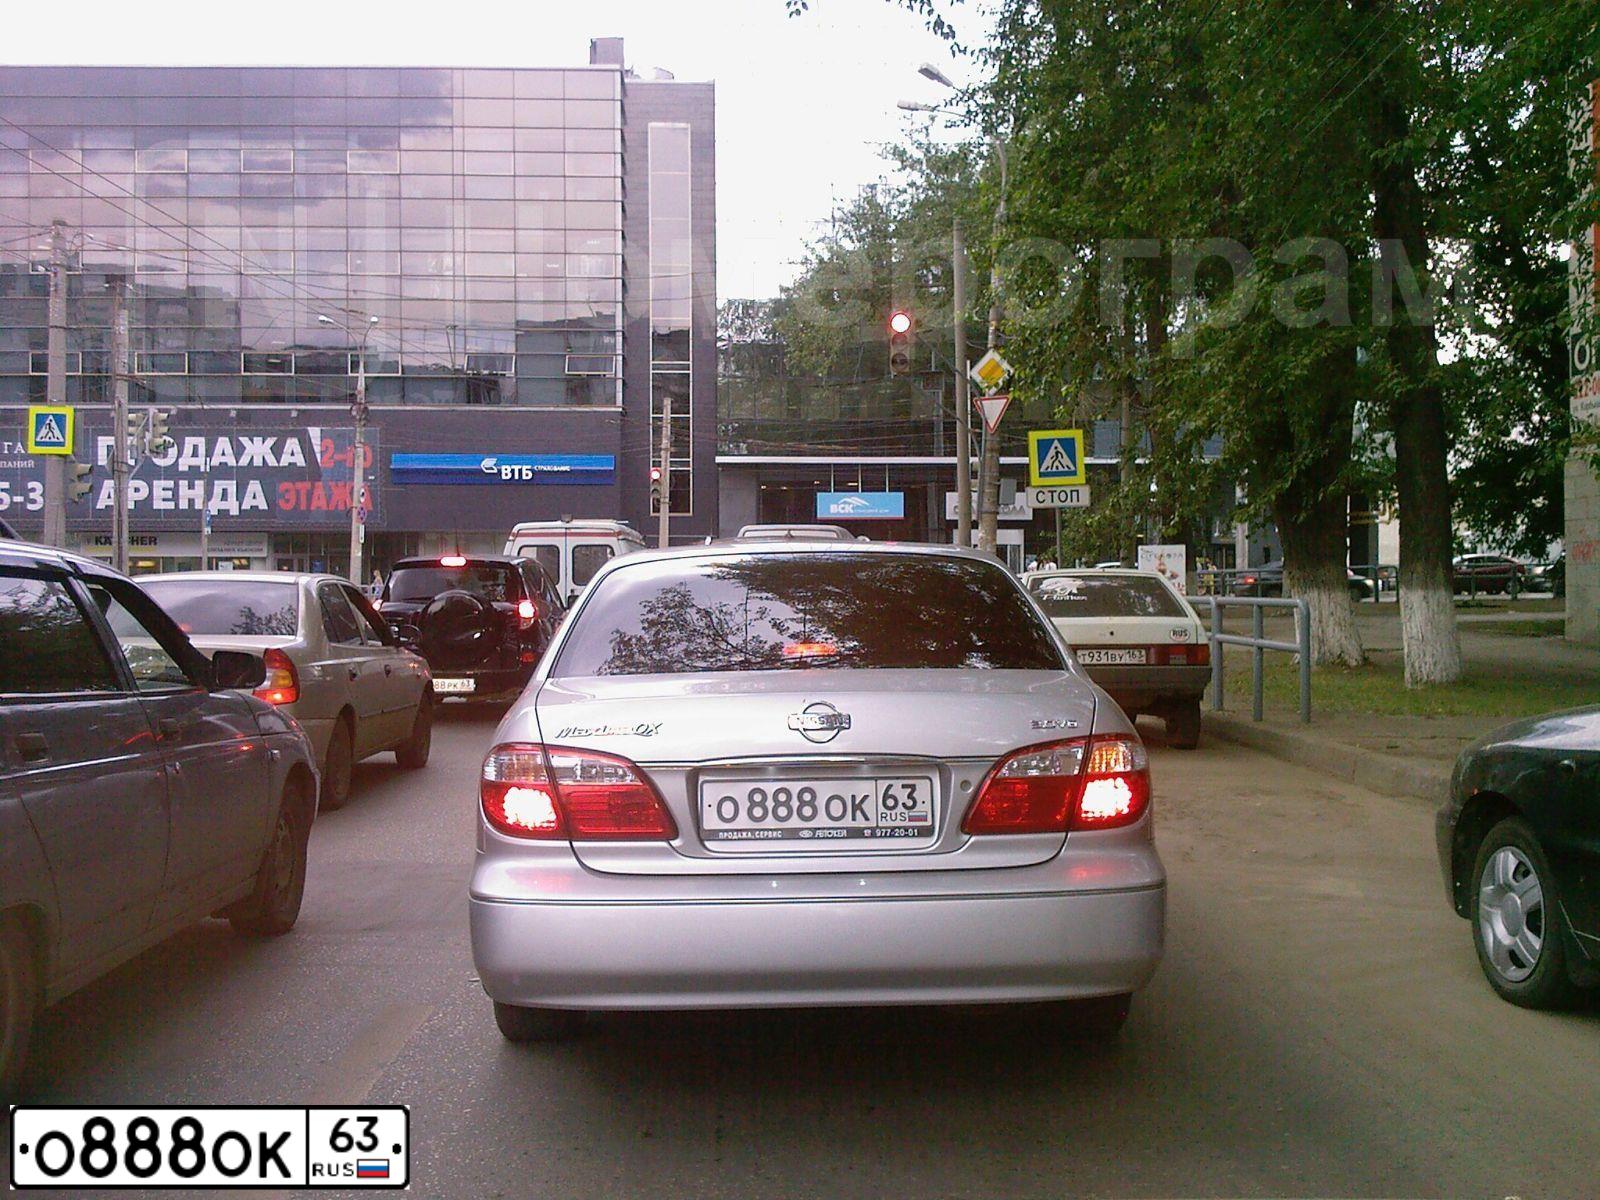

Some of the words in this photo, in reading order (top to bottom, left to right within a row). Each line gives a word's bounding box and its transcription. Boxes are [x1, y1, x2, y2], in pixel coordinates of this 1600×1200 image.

[501, 464, 533, 480] ВТБ
[96, 480, 268, 515] АРЕНДА
[1036, 489, 1080, 504] СТОП
[830, 503, 854, 514] ВСК
[94, 535, 158, 546] KÄHER
[716, 786, 870, 824] О888ОК
[881, 783, 918, 811] 63
[880, 811, 907, 823] RUS
